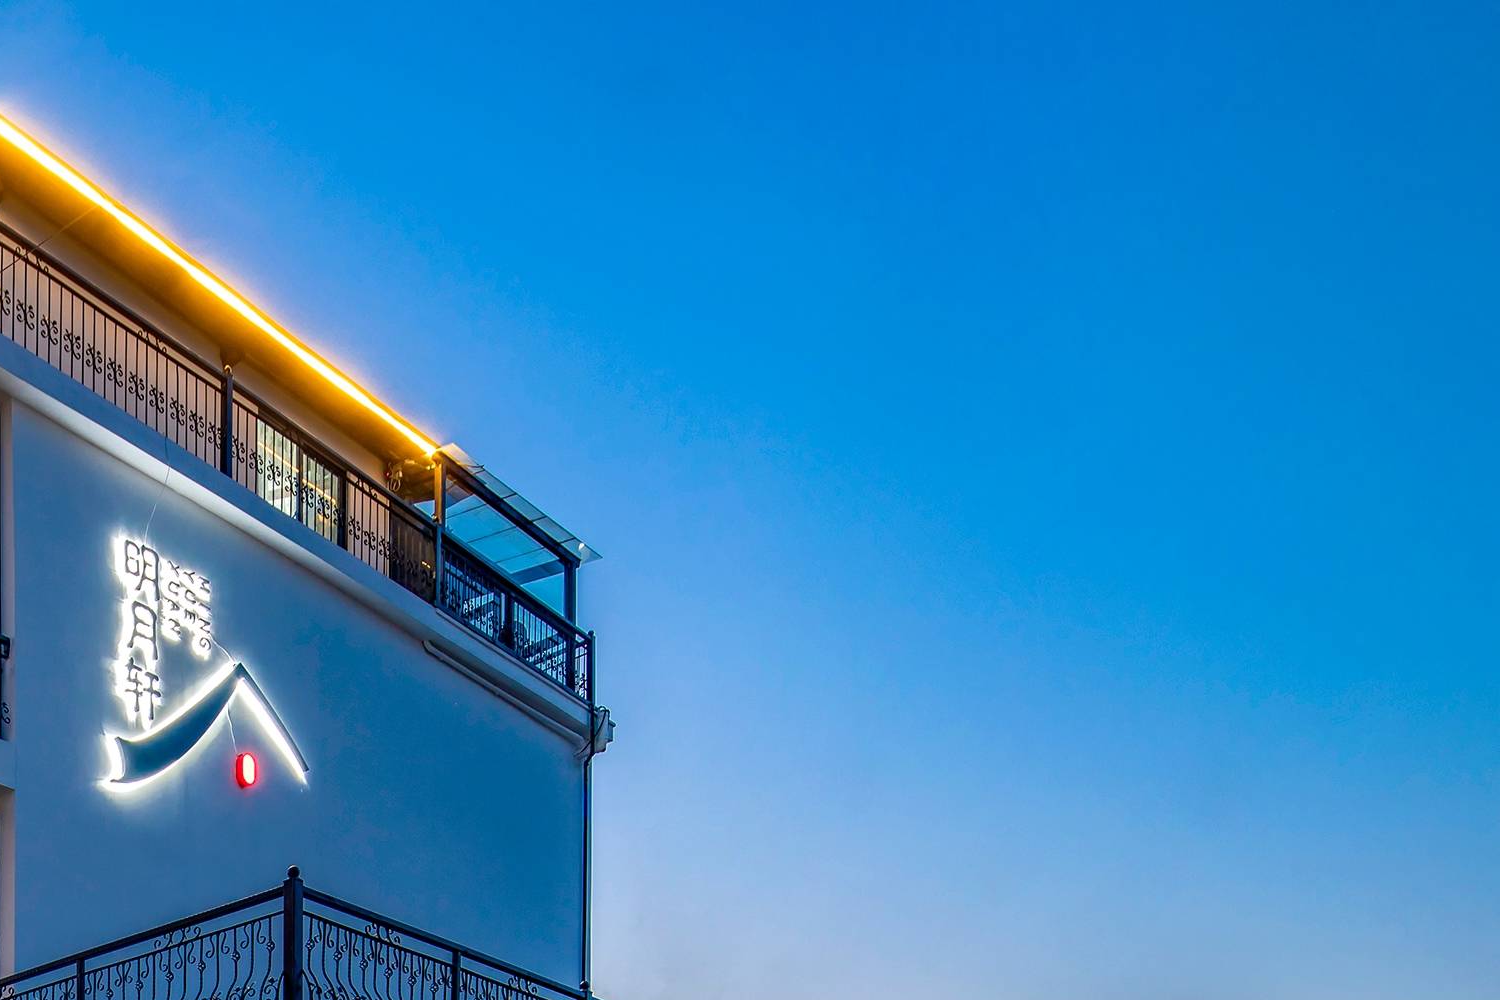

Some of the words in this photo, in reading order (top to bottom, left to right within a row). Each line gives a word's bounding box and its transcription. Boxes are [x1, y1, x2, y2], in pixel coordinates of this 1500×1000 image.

[124, 539, 162, 720] 明月轩
[167, 559, 182, 636] XUAN
[183, 570, 197, 624] YUE
[198, 576, 212, 651] MING
